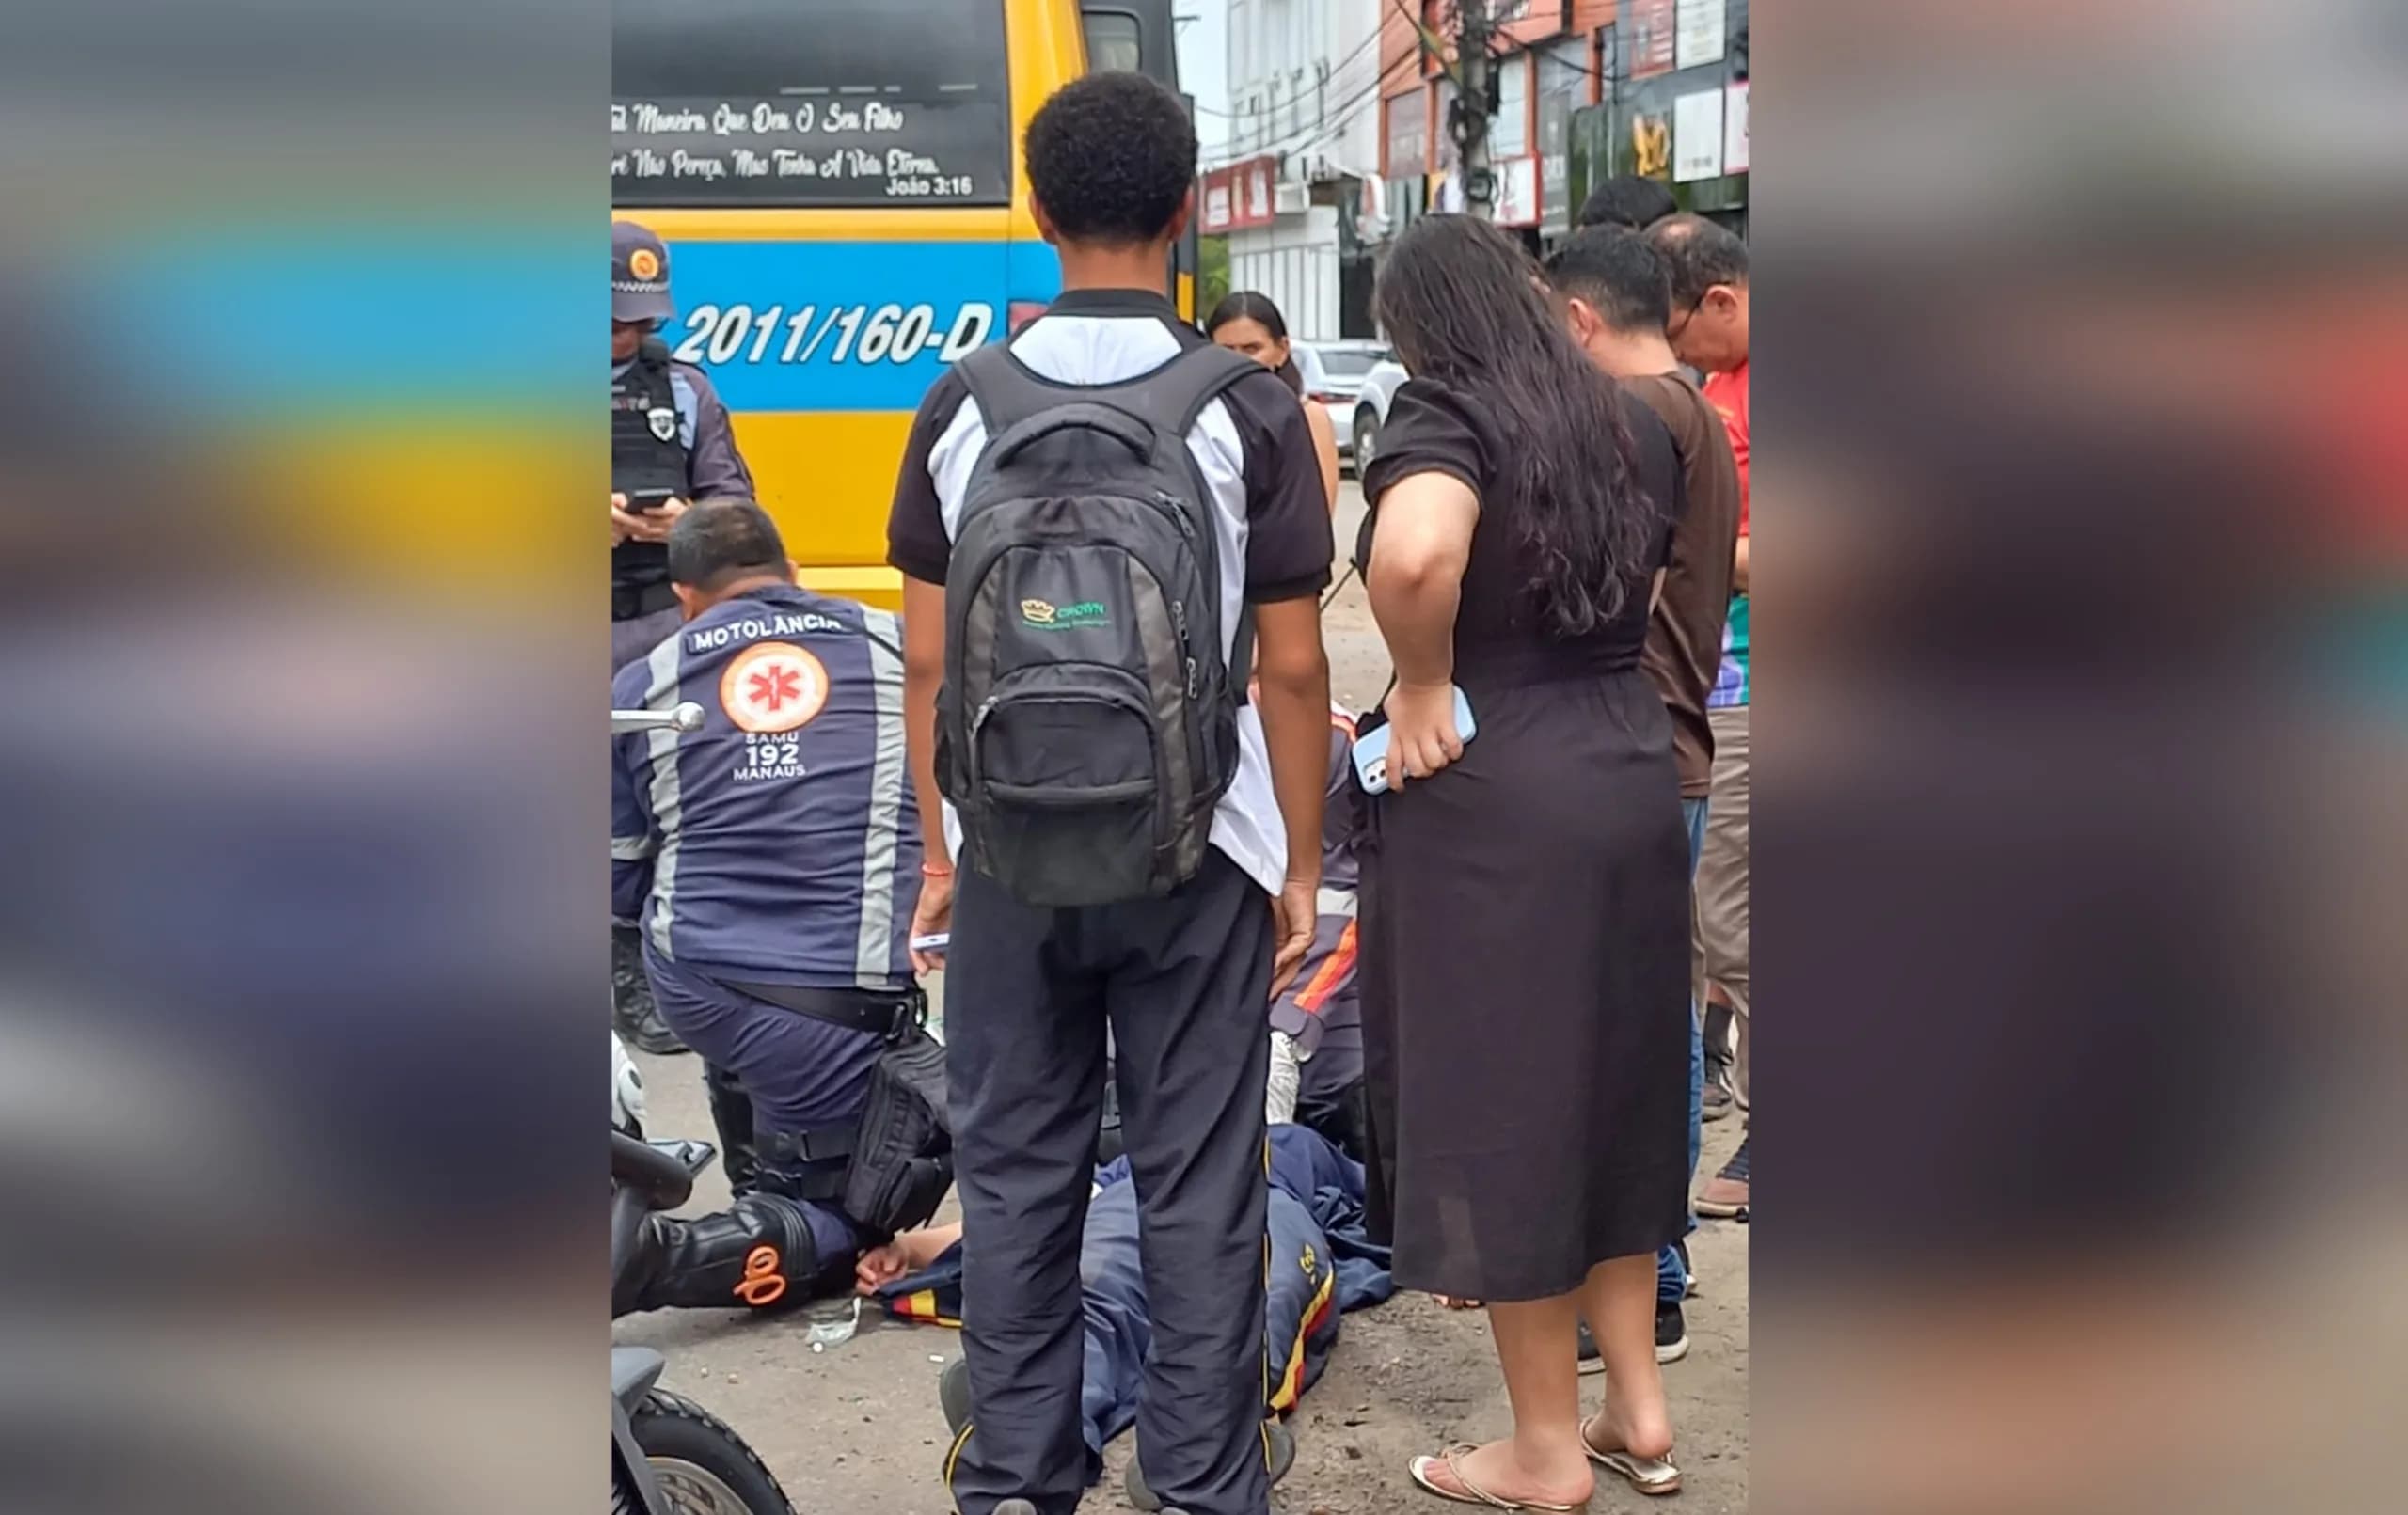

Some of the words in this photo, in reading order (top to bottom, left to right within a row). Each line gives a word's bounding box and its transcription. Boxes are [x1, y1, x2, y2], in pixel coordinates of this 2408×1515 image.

[713, 103, 749, 135] Que
[795, 102, 815, 133] O
[864, 101, 904, 133] Filho
[730, 149, 769, 178] Mas
[819, 149, 844, 179] A
[885, 176, 931, 196] João
[932, 176, 973, 196] 3:16
[671, 302, 993, 367] 2011/160-D
[1057, 602, 1106, 618] CROWN
[745, 731, 799, 745] SAMU
[745, 742, 800, 766] 192
[733, 763, 806, 781] MANAUS
